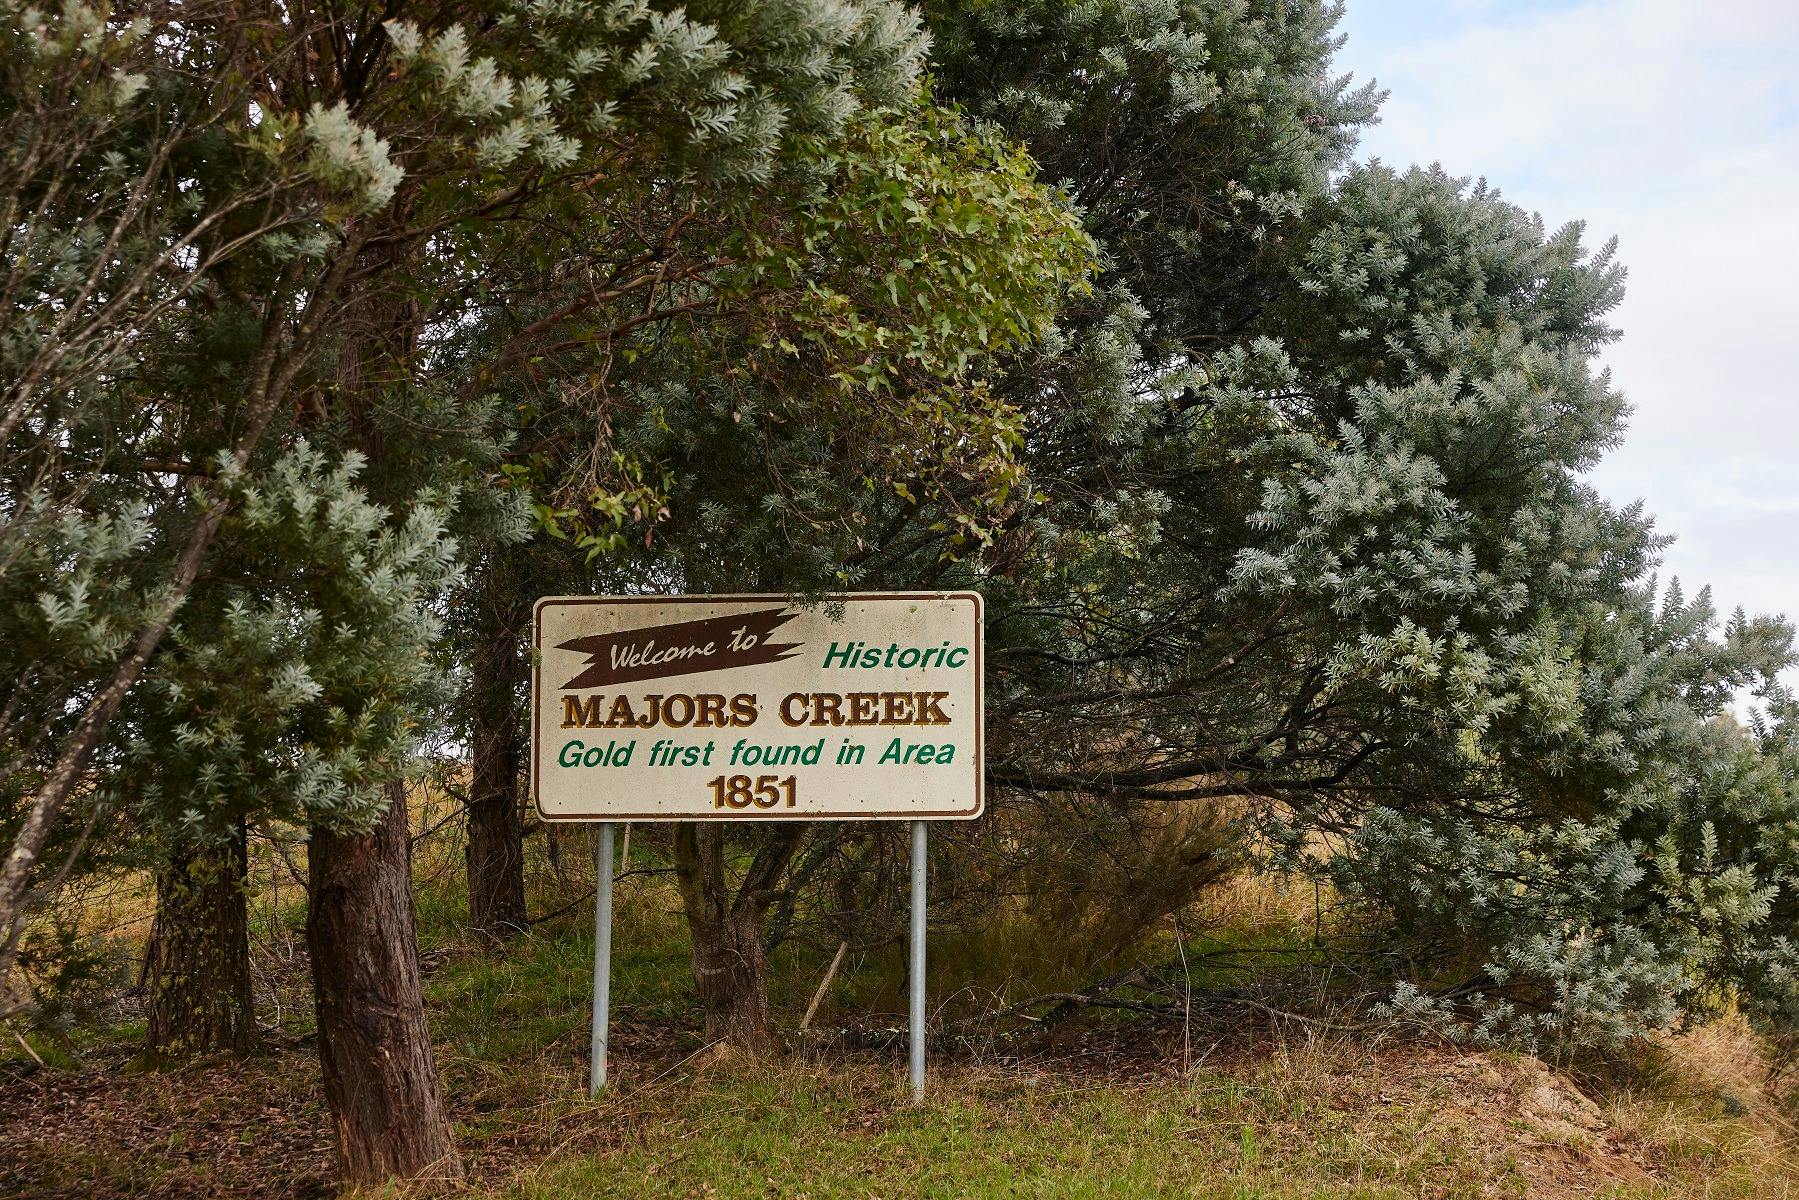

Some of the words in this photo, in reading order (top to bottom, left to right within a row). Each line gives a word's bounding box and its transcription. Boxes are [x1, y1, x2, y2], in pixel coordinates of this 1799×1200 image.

[609, 640, 717, 671] Welcome
[727, 625, 758, 652] to
[822, 641, 970, 669] Historic
[561, 693, 759, 729] MAJORS
[779, 691, 952, 727] CREEK
[558, 740, 636, 768] Gold
[648, 739, 715, 767] first
[729, 738, 825, 767] found
[835, 738, 866, 766] in
[877, 737, 956, 765] Area
[706, 775, 798, 809] 1851
